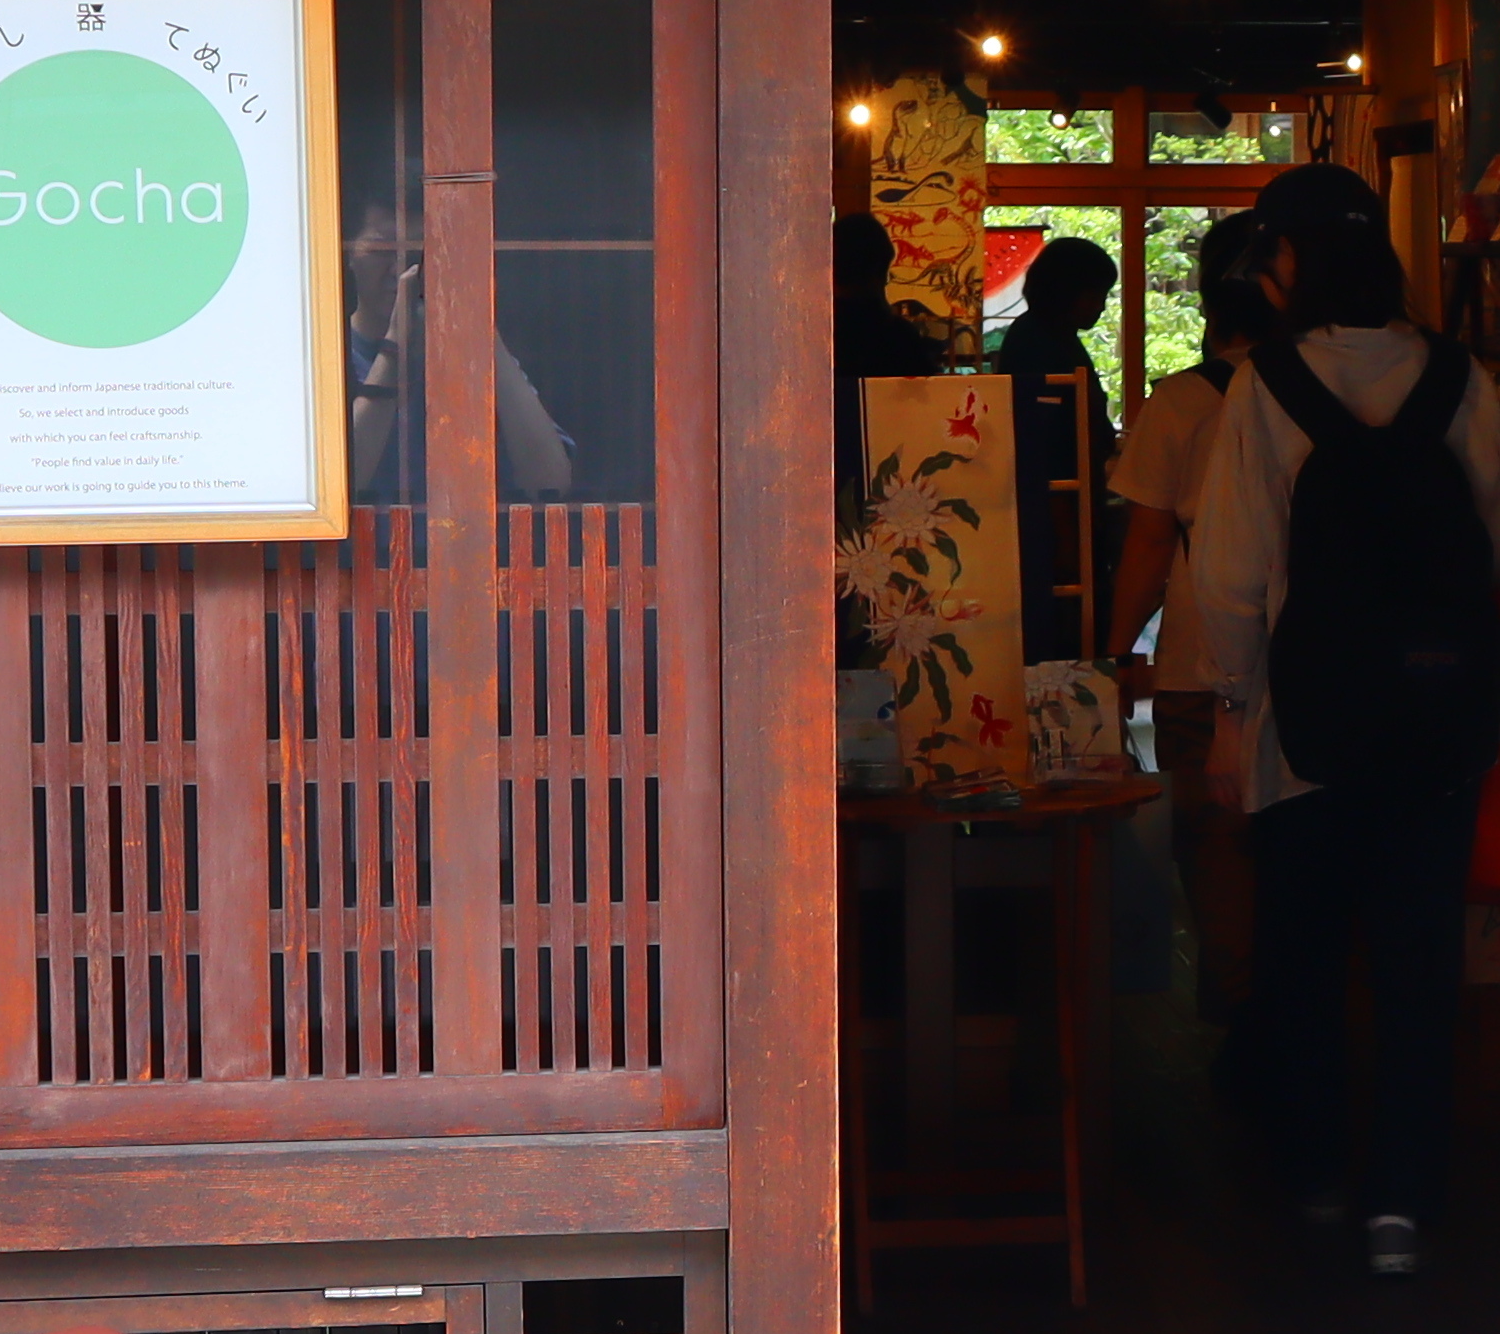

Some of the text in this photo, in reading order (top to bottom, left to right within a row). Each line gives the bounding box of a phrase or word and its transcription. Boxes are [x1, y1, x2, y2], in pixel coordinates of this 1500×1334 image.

[164, 22, 267, 123] てぬぐい
[37, 383, 56, 393] and
[58, 382, 92, 392] inform
[95, 382, 141, 394] Japanese
[143, 380, 195, 391] traditional
[197, 380, 235, 390] culture.
[18, 406, 189, 419] So, we select and introduce goods
[10, 430, 202, 445] with which you can feel craftsmanship.
[72, 456, 92, 467] find
[94, 456, 121, 466] value
[123, 456, 133, 466] in
[135, 455, 159, 468] daily
[25, 484, 42, 492] our
[45, 482, 70, 492] work
[72, 482, 80, 491] is
[82, 482, 112, 494] going
[114, 482, 125, 491] to
[127, 480, 155, 493] guide
[158, 482, 177, 492] you
[180, 481, 190, 490] to
[193, 479, 211, 489] this
[213, 478, 248, 489] theme.
